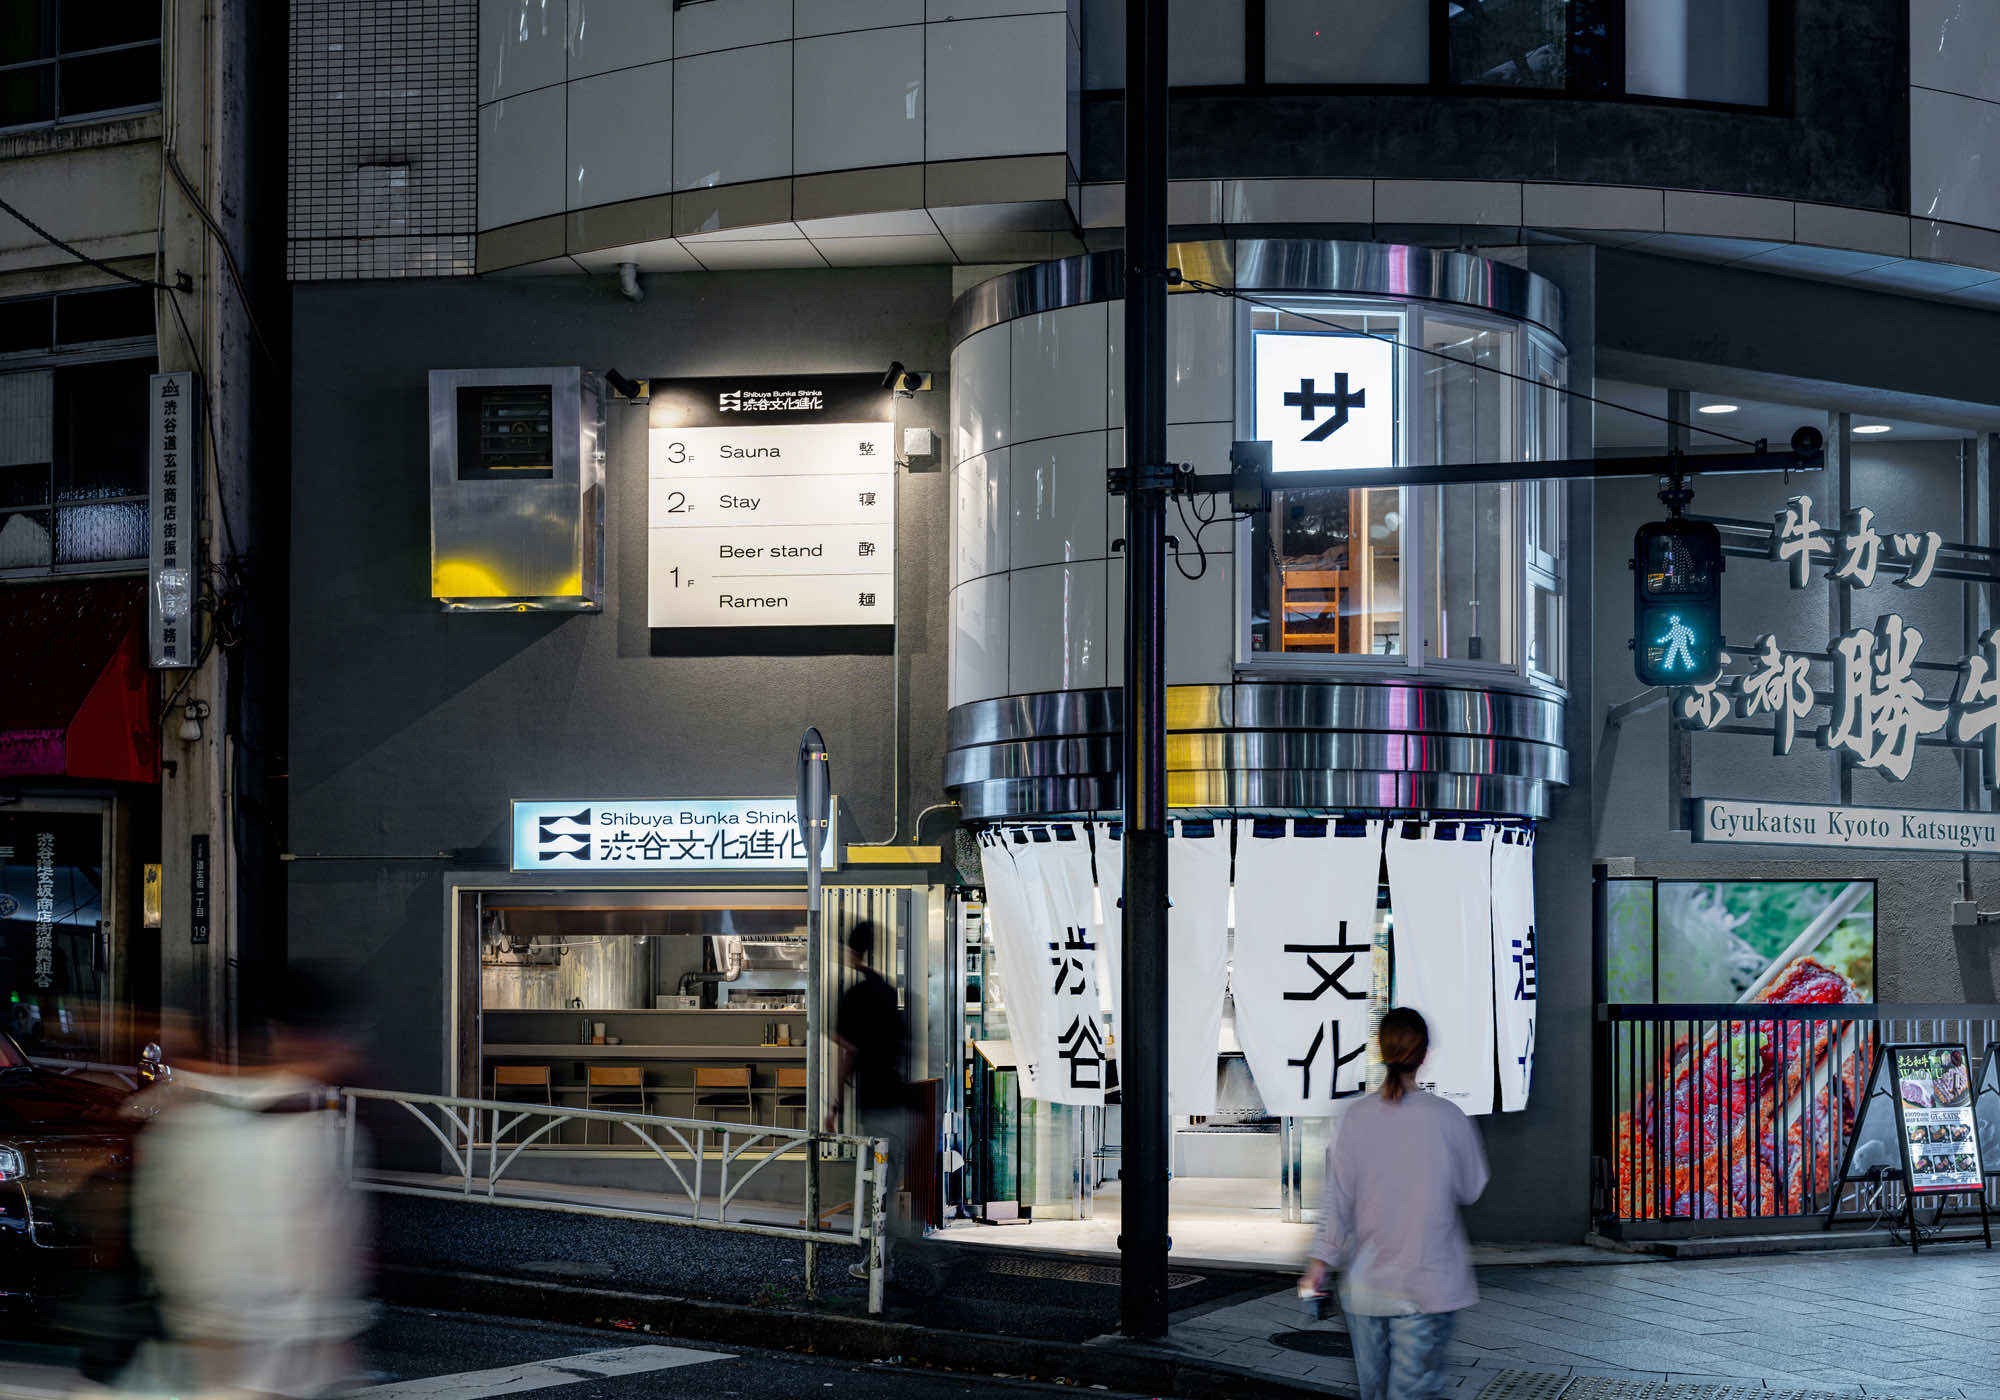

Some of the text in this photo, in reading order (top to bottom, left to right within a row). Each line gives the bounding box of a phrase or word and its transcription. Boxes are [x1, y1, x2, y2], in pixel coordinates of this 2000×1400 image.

[743, 391, 771, 399] Shibuya
[773, 390, 796, 398] Bunka
[743, 397, 823, 411] 渋谷文化進化
[1284, 372, 1366, 442] サ
[719, 445, 781, 459] Sauna
[859, 442, 876, 456] 整
[719, 494, 761, 511] Stay
[1779, 495, 1943, 588] 牛カツ
[720, 544, 823, 559] Beer stand
[859, 542, 876, 557] 酔
[719, 595, 789, 609] Ramen
[600, 810, 798, 828] Shibuya Bunka Shink
[1710, 805, 1996, 847] Gyukatsu Kyoto Katsugyu
[600, 828, 808, 861] 渋谷文化進化
[193, 925, 207, 938] 19
[1284, 920, 1371, 1101] 文化
